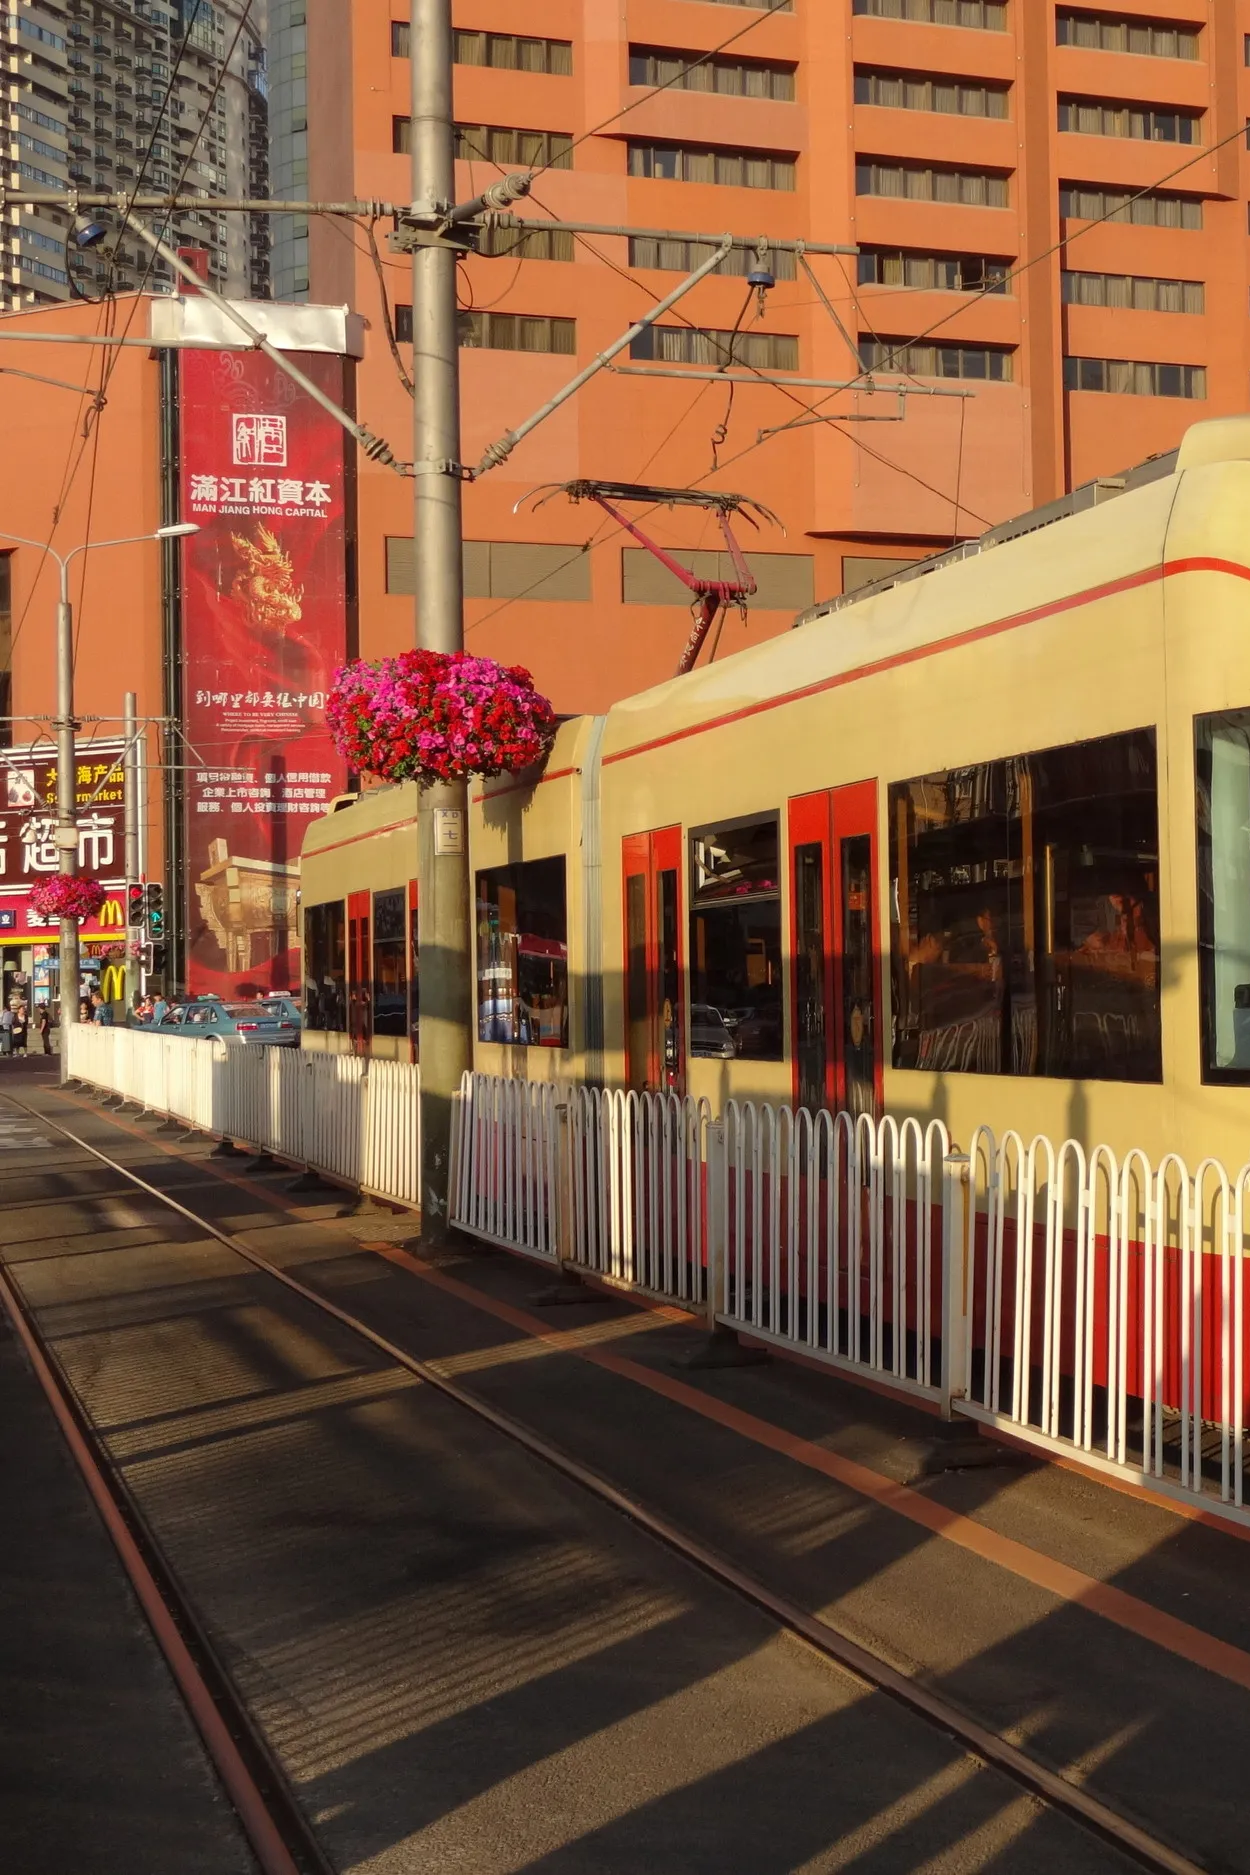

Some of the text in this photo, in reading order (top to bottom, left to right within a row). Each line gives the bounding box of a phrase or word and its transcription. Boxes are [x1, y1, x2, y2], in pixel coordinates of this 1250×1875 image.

[190, 473, 332, 507] 滿江紅資本
[192, 503, 328, 518] MAN JIANG HONG CAPITAL
[46, 764, 124, 787] 大海产品
